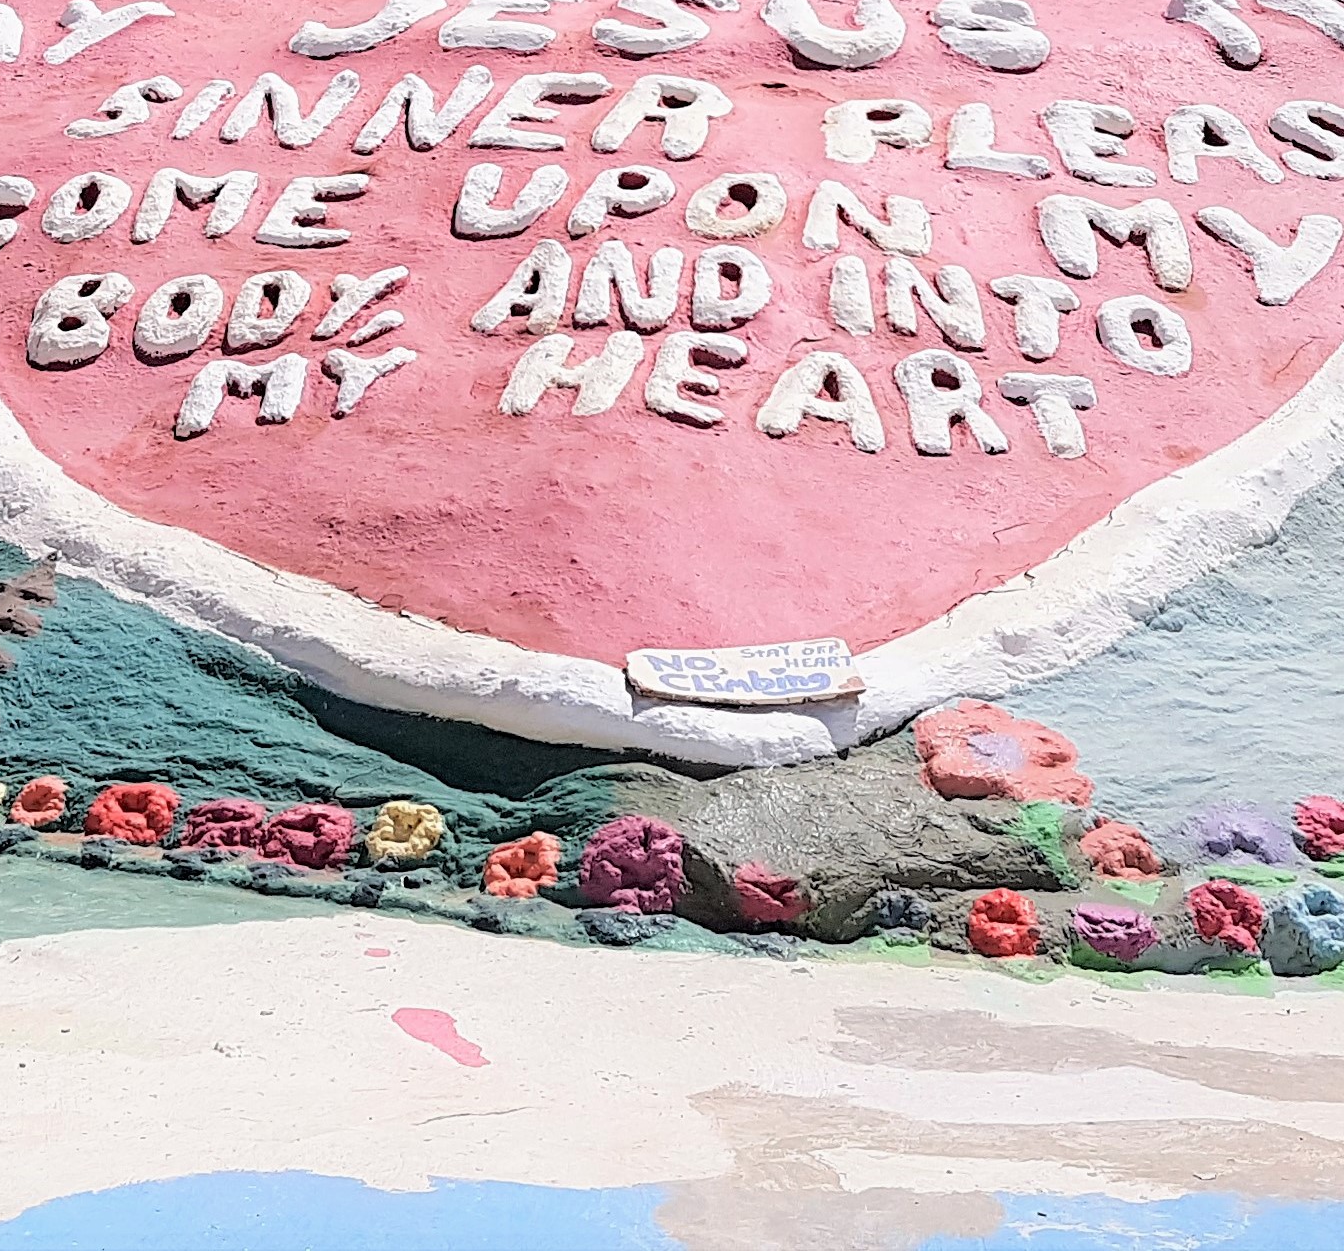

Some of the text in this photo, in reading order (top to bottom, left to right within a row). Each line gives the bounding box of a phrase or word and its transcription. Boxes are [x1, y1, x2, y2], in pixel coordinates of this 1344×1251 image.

[64, 64, 733, 159] SINNER
[451, 162, 933, 257] UPON
[1037, 194, 1344, 307] MY
[470, 237, 773, 335] AND
[829, 255, 1194, 378] INTO
[172, 328, 1098, 459] MY HEART
[784, 655, 852, 669] HEART
